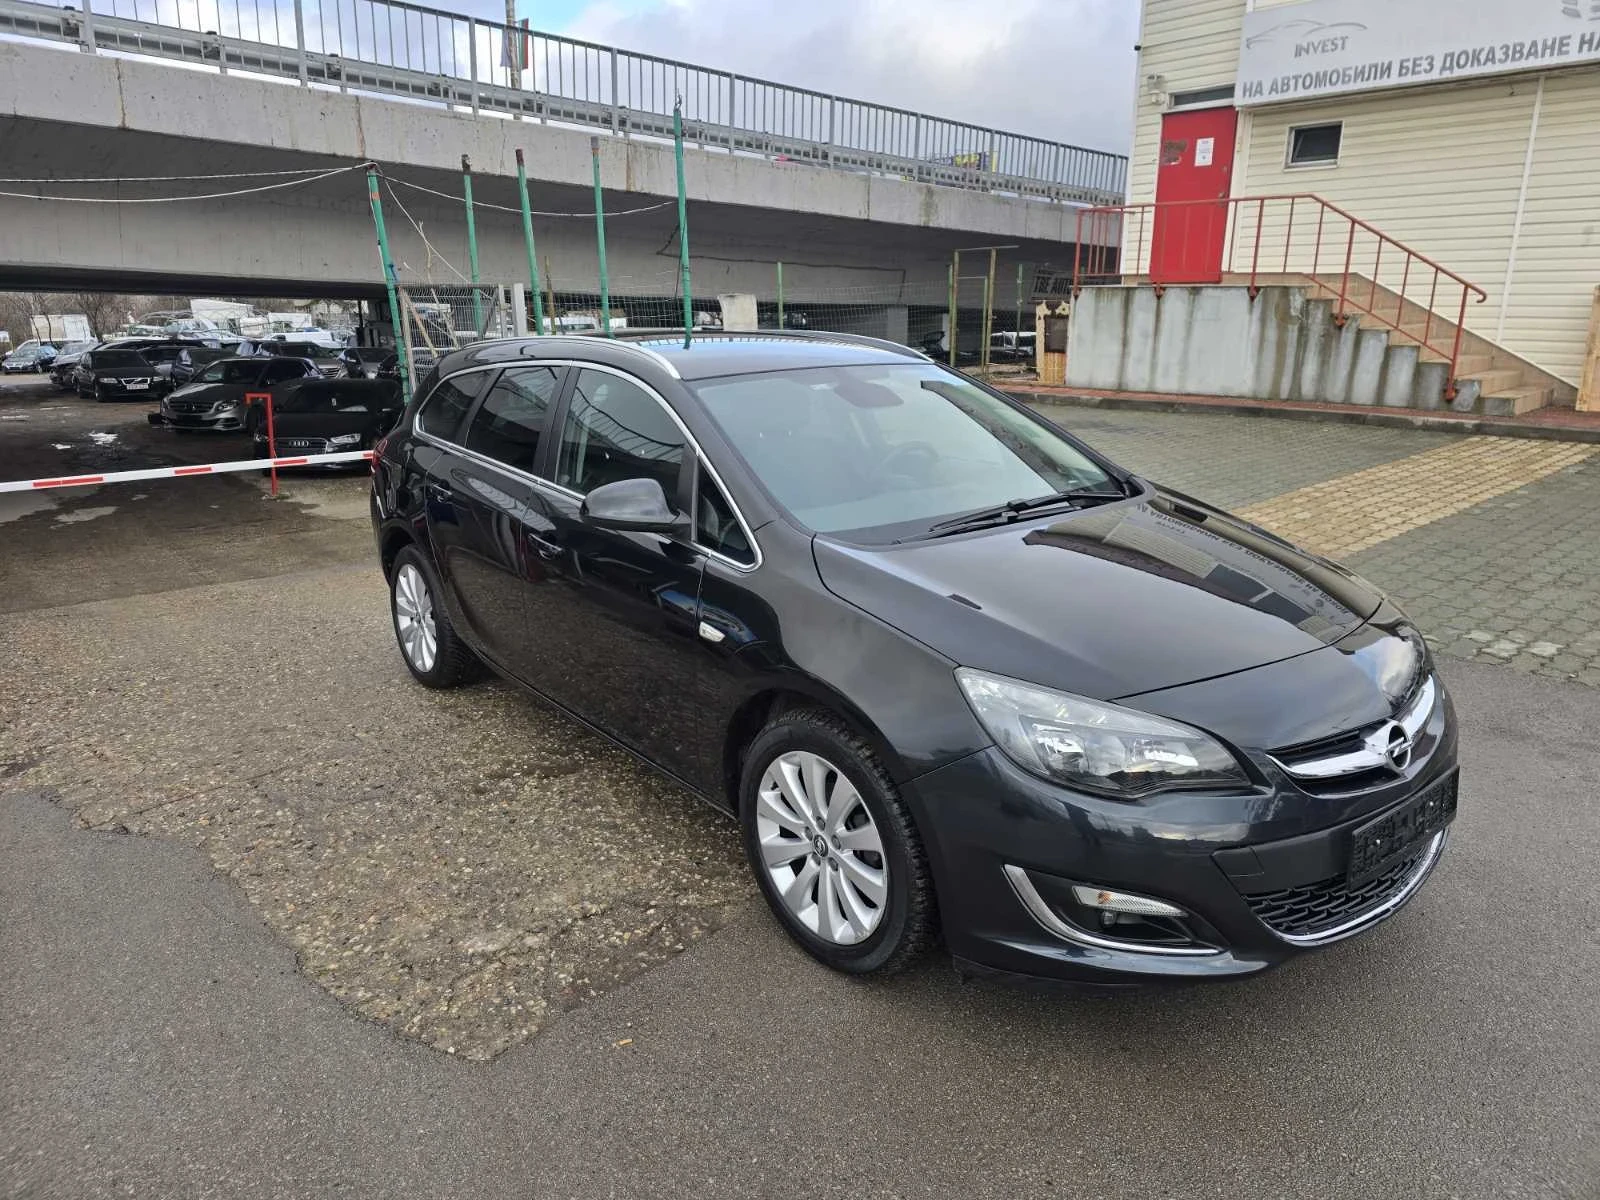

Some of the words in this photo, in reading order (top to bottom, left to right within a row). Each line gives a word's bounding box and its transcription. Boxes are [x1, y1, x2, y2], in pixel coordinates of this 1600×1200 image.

[1242, 80, 1264, 98] НА
[1268, 60, 1393, 95] АВТОМОБИЛИ
[1398, 55, 1435, 78] БЕЗ
[1440, 35, 1572, 75] ДОКАЗВАНЕ
[1294, 36, 1349, 58] INVEST
